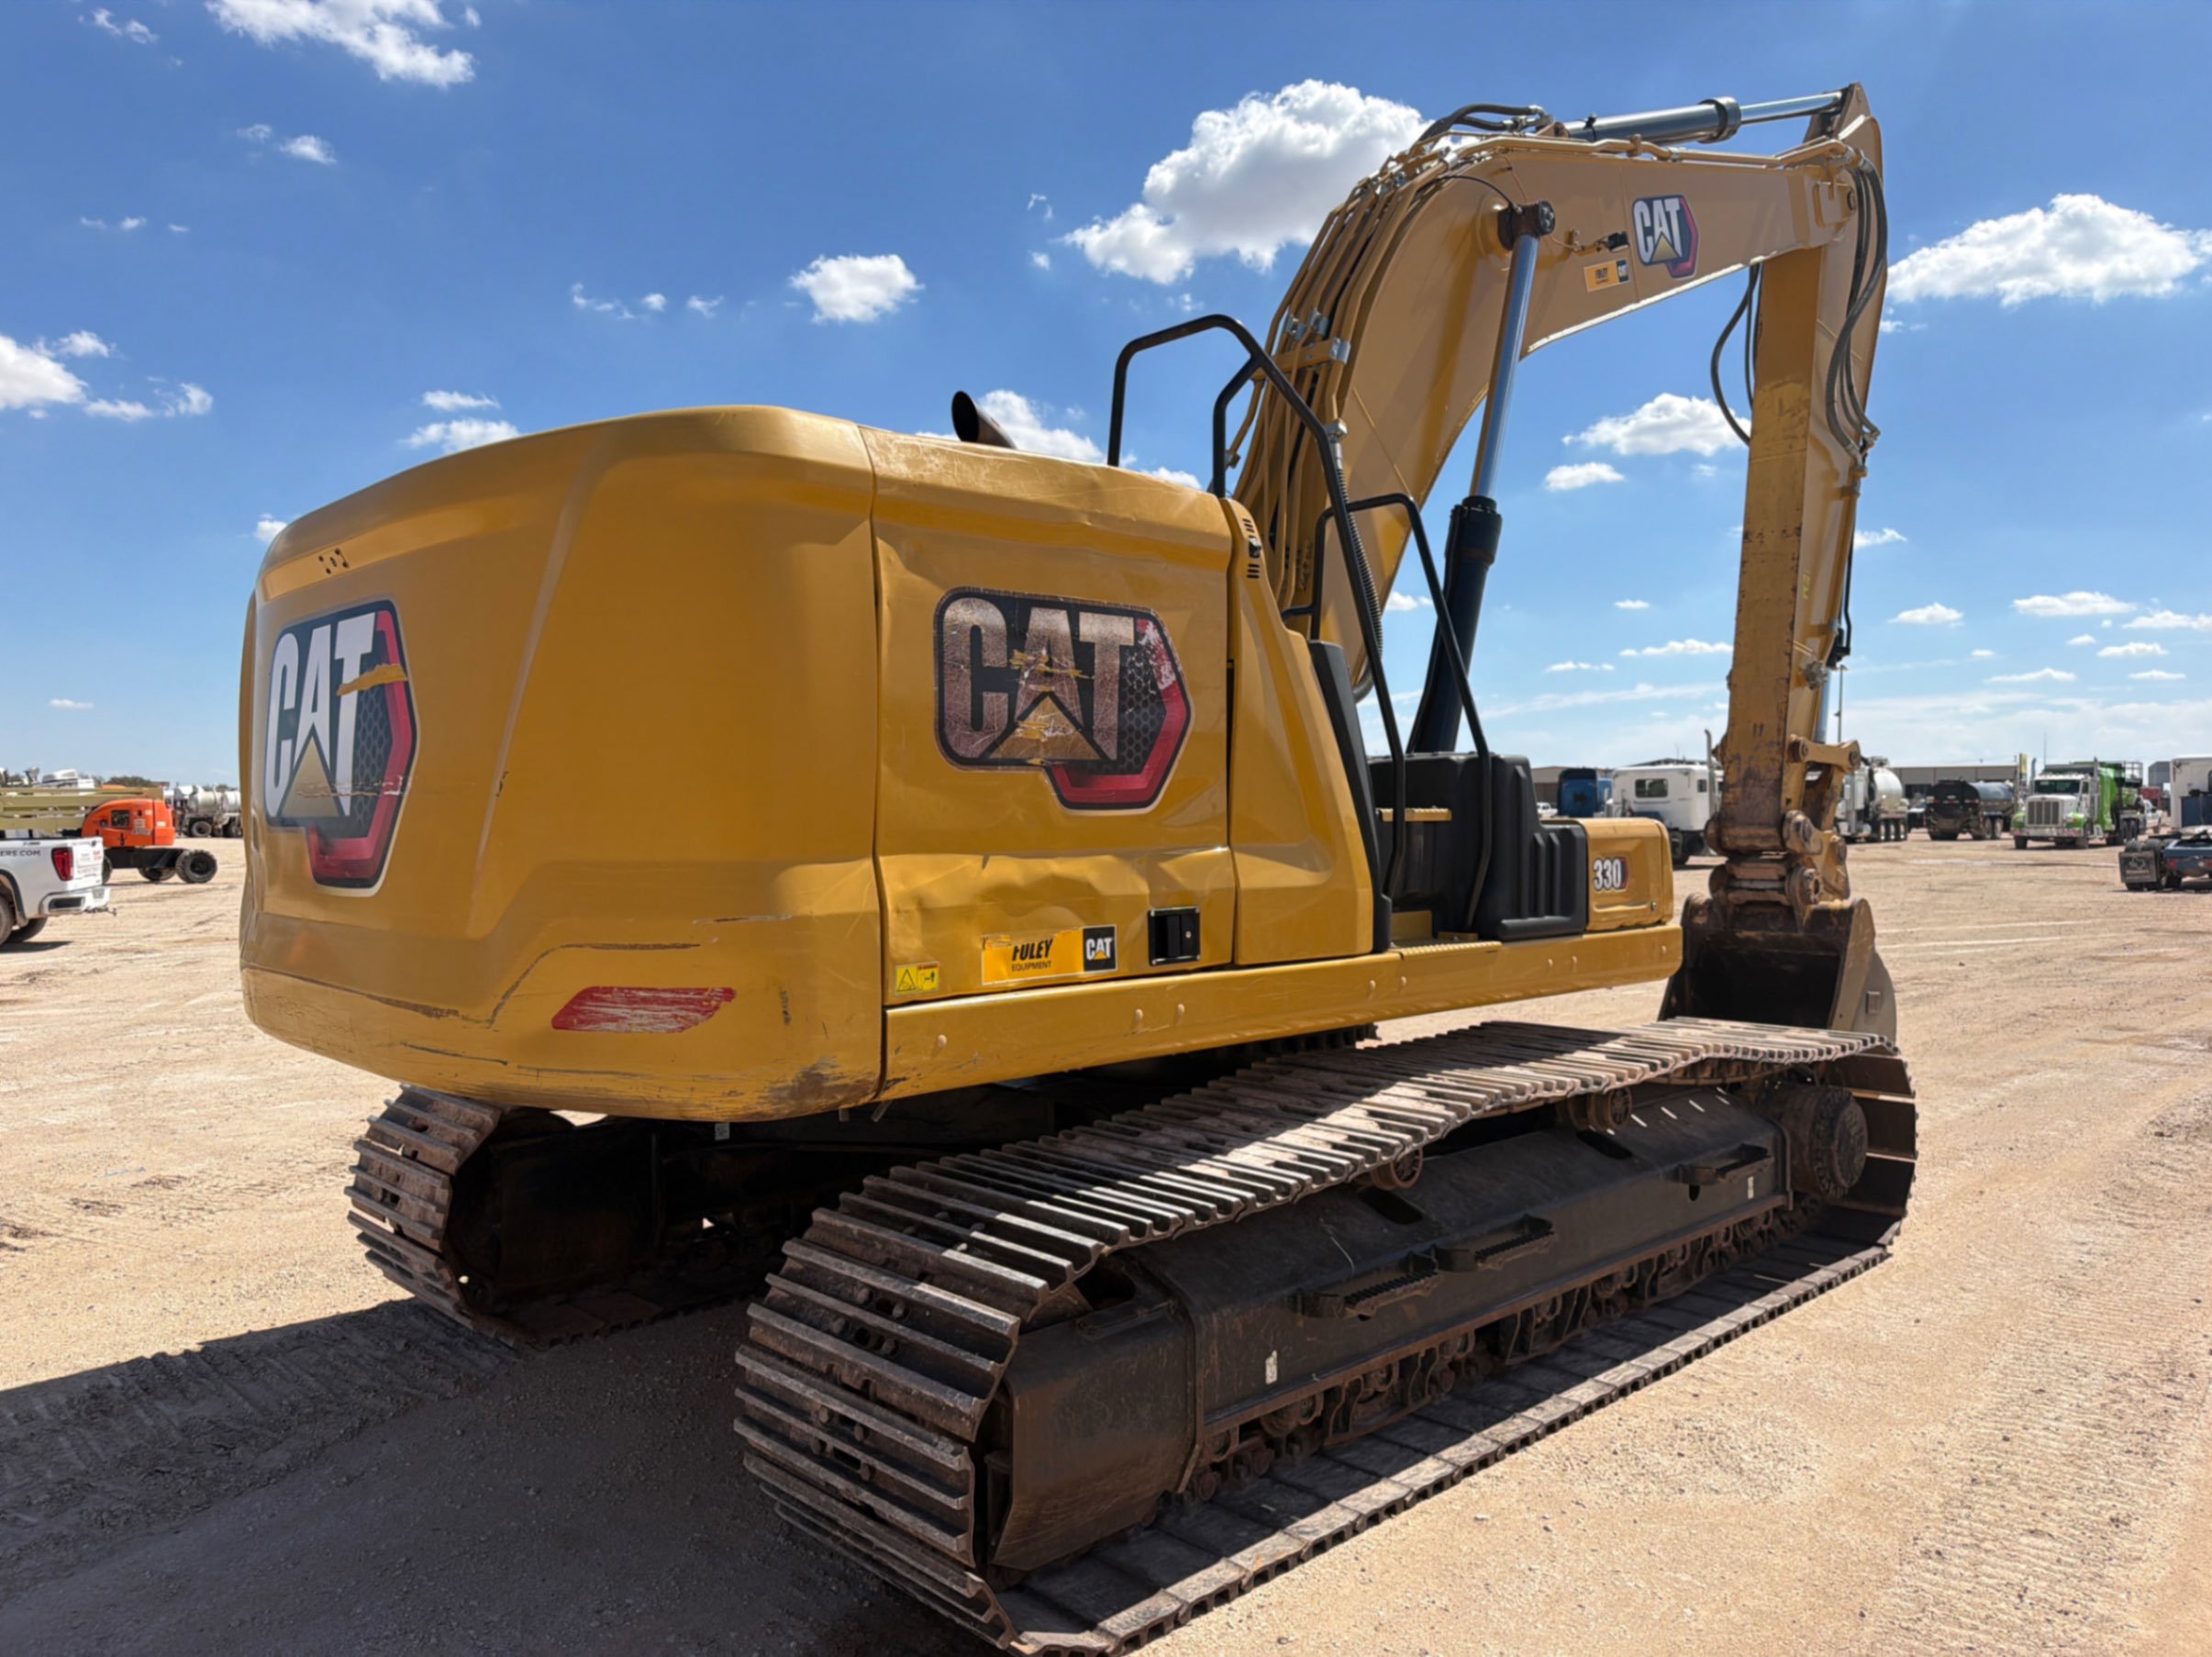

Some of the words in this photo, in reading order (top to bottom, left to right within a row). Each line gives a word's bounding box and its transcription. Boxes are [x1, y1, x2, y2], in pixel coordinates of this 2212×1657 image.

[1634, 197, 1683, 263] CAT
[943, 597, 1134, 761] CAT
[264, 612, 376, 817] CAT
[1593, 858, 1622, 890] 330
[1012, 961, 1052, 973] EQUIPMENT
[1085, 937, 1113, 961] CAT
